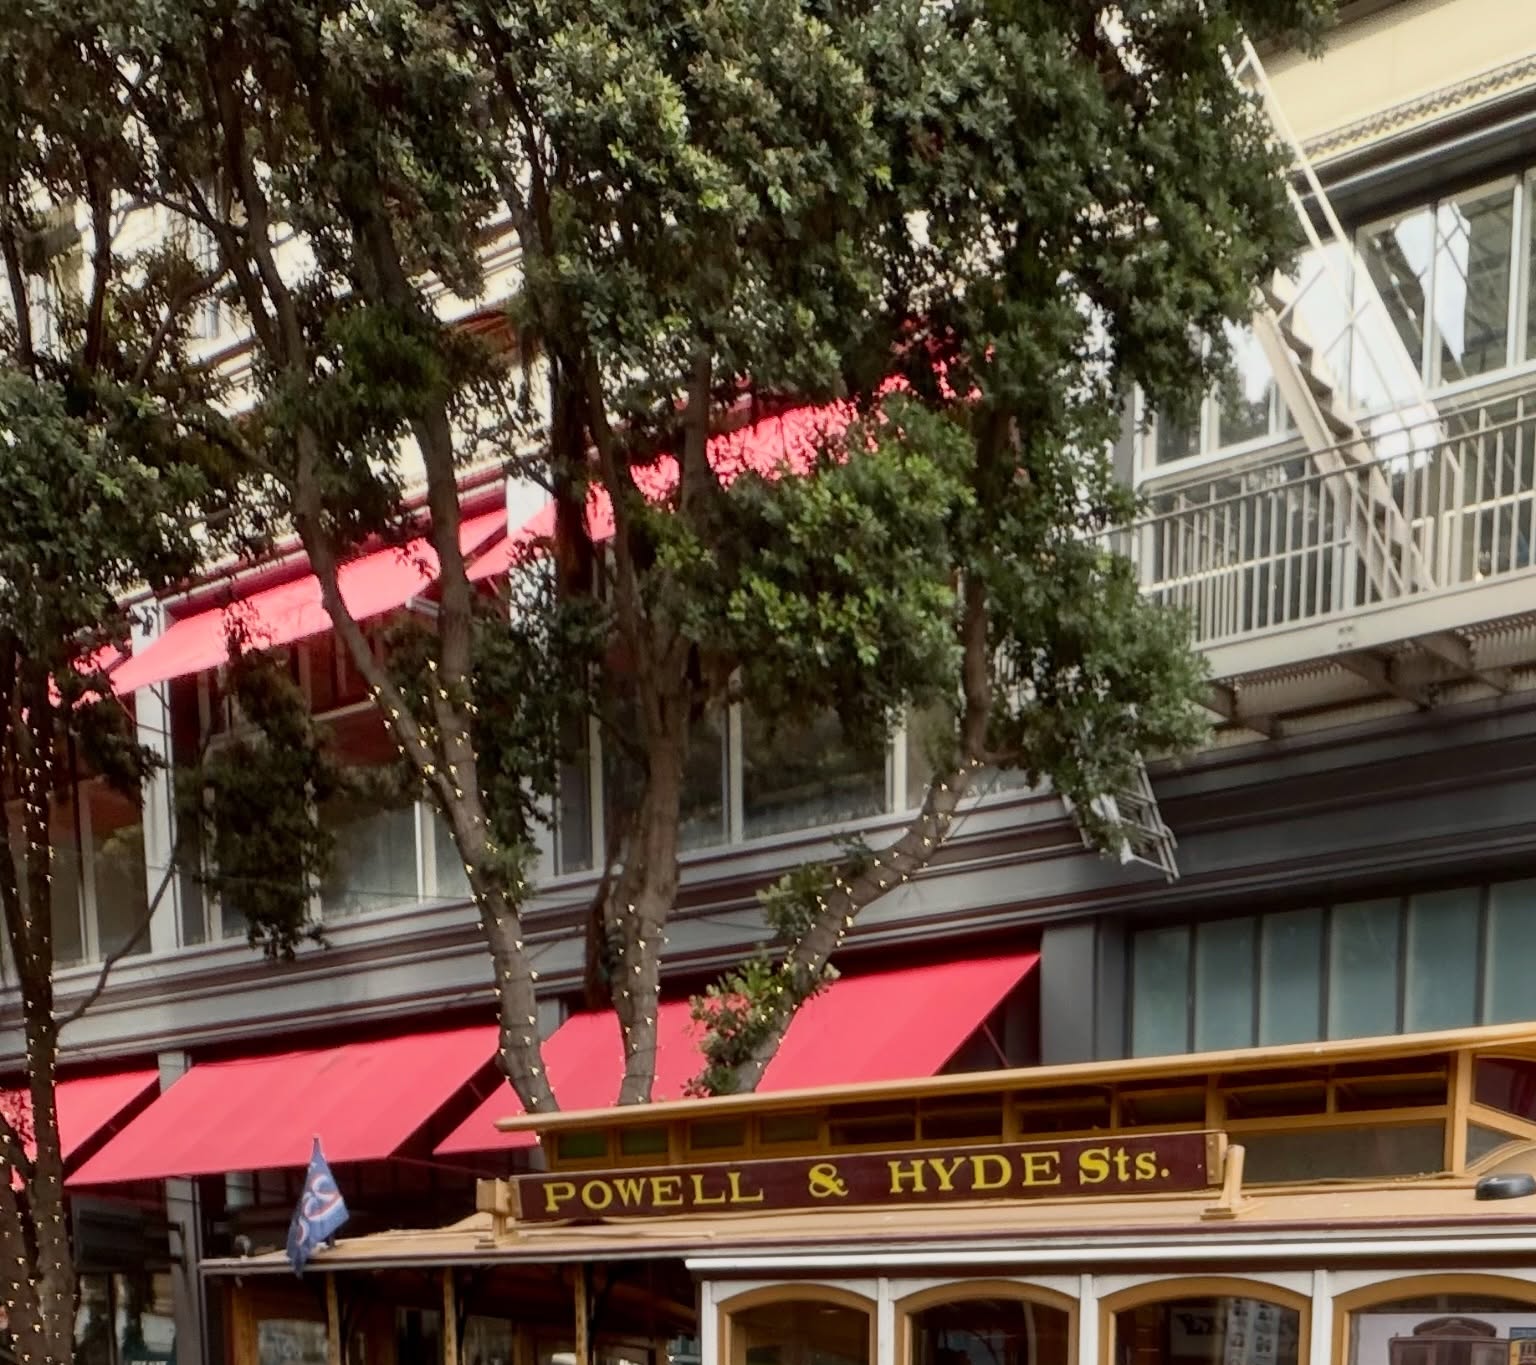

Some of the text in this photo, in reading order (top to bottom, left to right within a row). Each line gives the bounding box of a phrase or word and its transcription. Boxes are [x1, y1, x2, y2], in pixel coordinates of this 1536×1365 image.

[543, 1147, 1170, 1213] POWELL & HYDE Sts.
